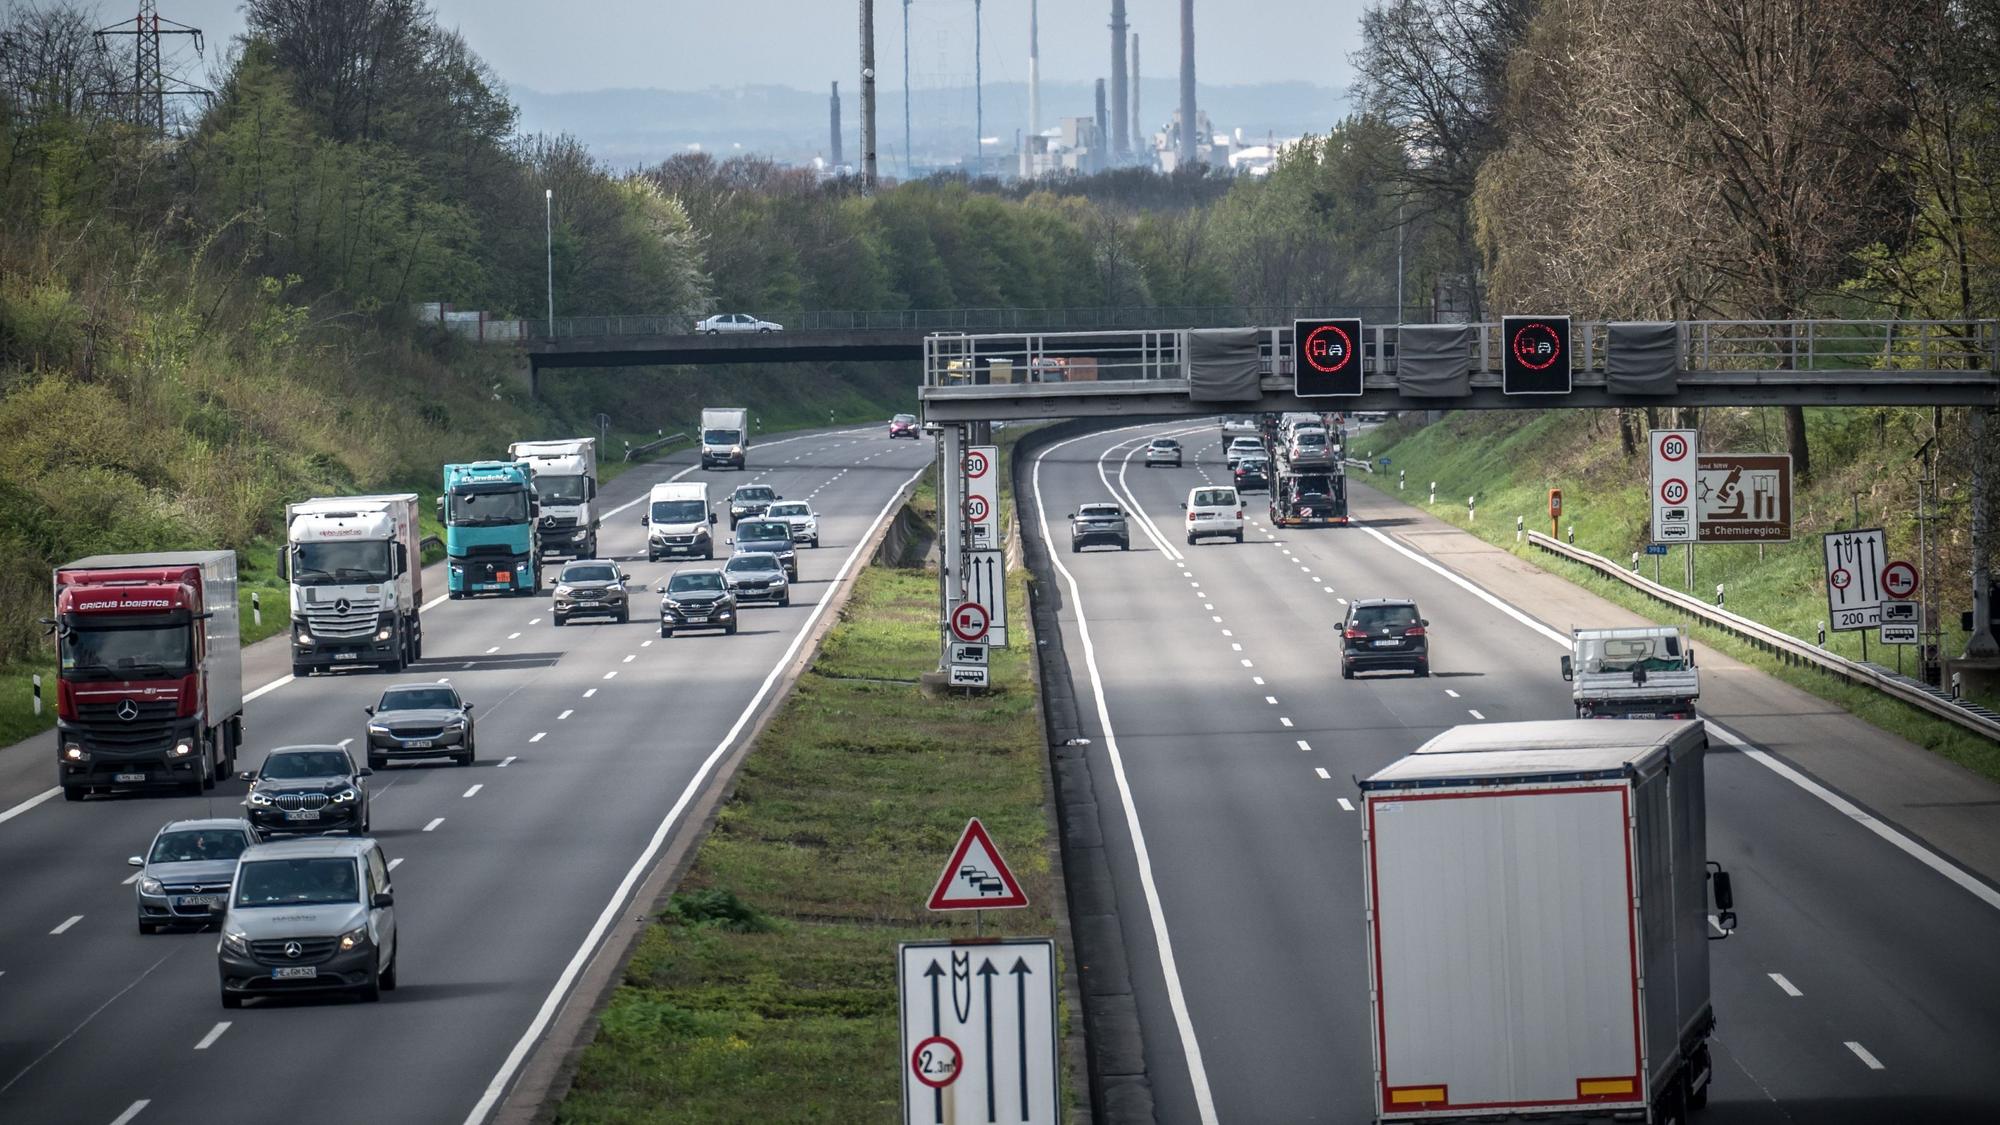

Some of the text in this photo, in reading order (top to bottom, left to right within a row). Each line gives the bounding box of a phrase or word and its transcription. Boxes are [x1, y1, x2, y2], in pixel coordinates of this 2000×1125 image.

[1666, 442, 1682, 455] 80
[1667, 486, 1682, 498] 60
[969, 502, 983, 515] 60
[1714, 525, 1780, 537] Chemieregion
[80, 599, 169, 610] GRICIUS LOGISTICS
[1841, 612, 1881, 626] 200 m
